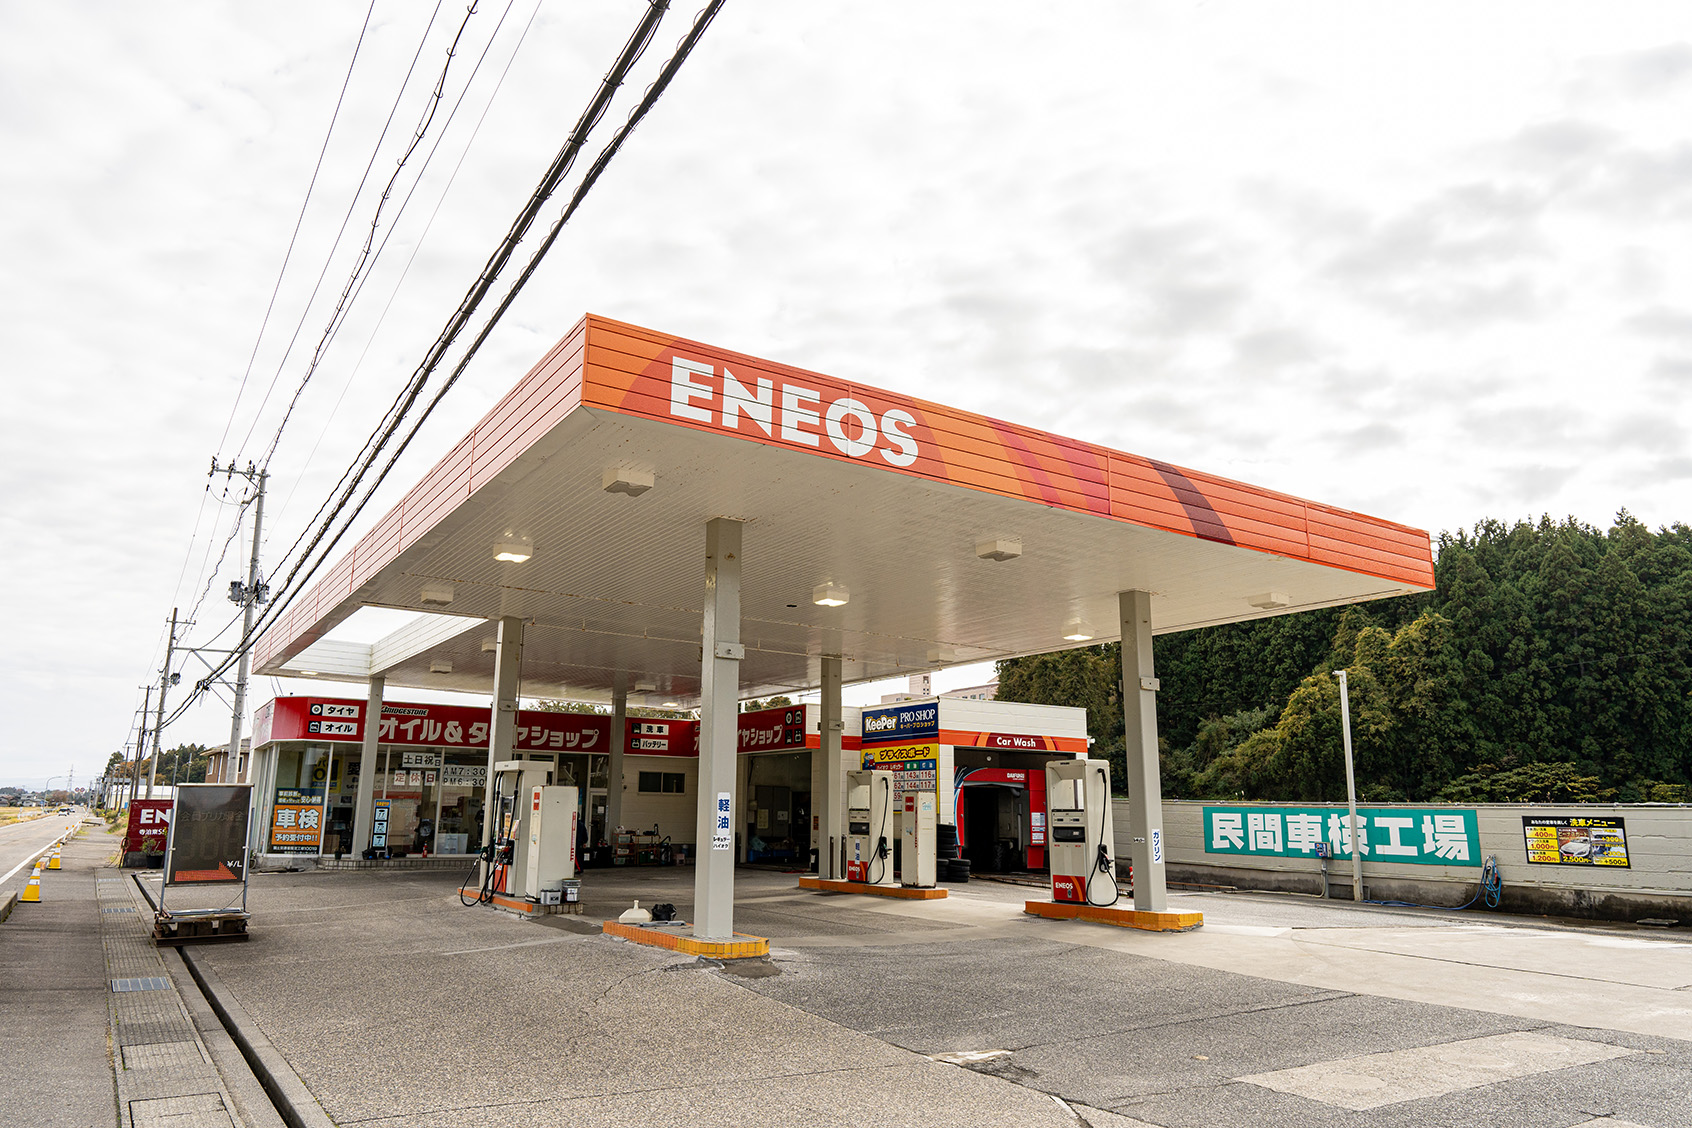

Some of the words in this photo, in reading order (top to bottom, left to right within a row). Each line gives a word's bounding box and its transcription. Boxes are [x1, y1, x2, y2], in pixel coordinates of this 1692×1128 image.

[670, 355, 919, 467] ENEOS
[327, 706, 355, 716] タイヤ
[381, 705, 429, 717] BRIDGESTONE
[900, 711, 914, 723] PRO
[916, 708, 936, 721] SHOP
[325, 723, 353, 733] オイル
[646, 724, 664, 734] 洗車
[865, 715, 897, 732] KeePer
[642, 740, 667, 748] バッテリー
[996, 737, 1012, 746] Car
[1014, 738, 1036, 747] Wash
[879, 747, 931, 760] プライスボード
[276, 808, 320, 829] 車検
[717, 798, 730, 829] 軽油
[1570, 818, 1615, 827] 洗車メニュー
[275, 834, 319, 842] 予約受付中!!
[1211, 812, 1470, 860] 民間車検工場
[1152, 831, 1161, 862] ガソリン
[1055, 882, 1073, 890] ENEOS
